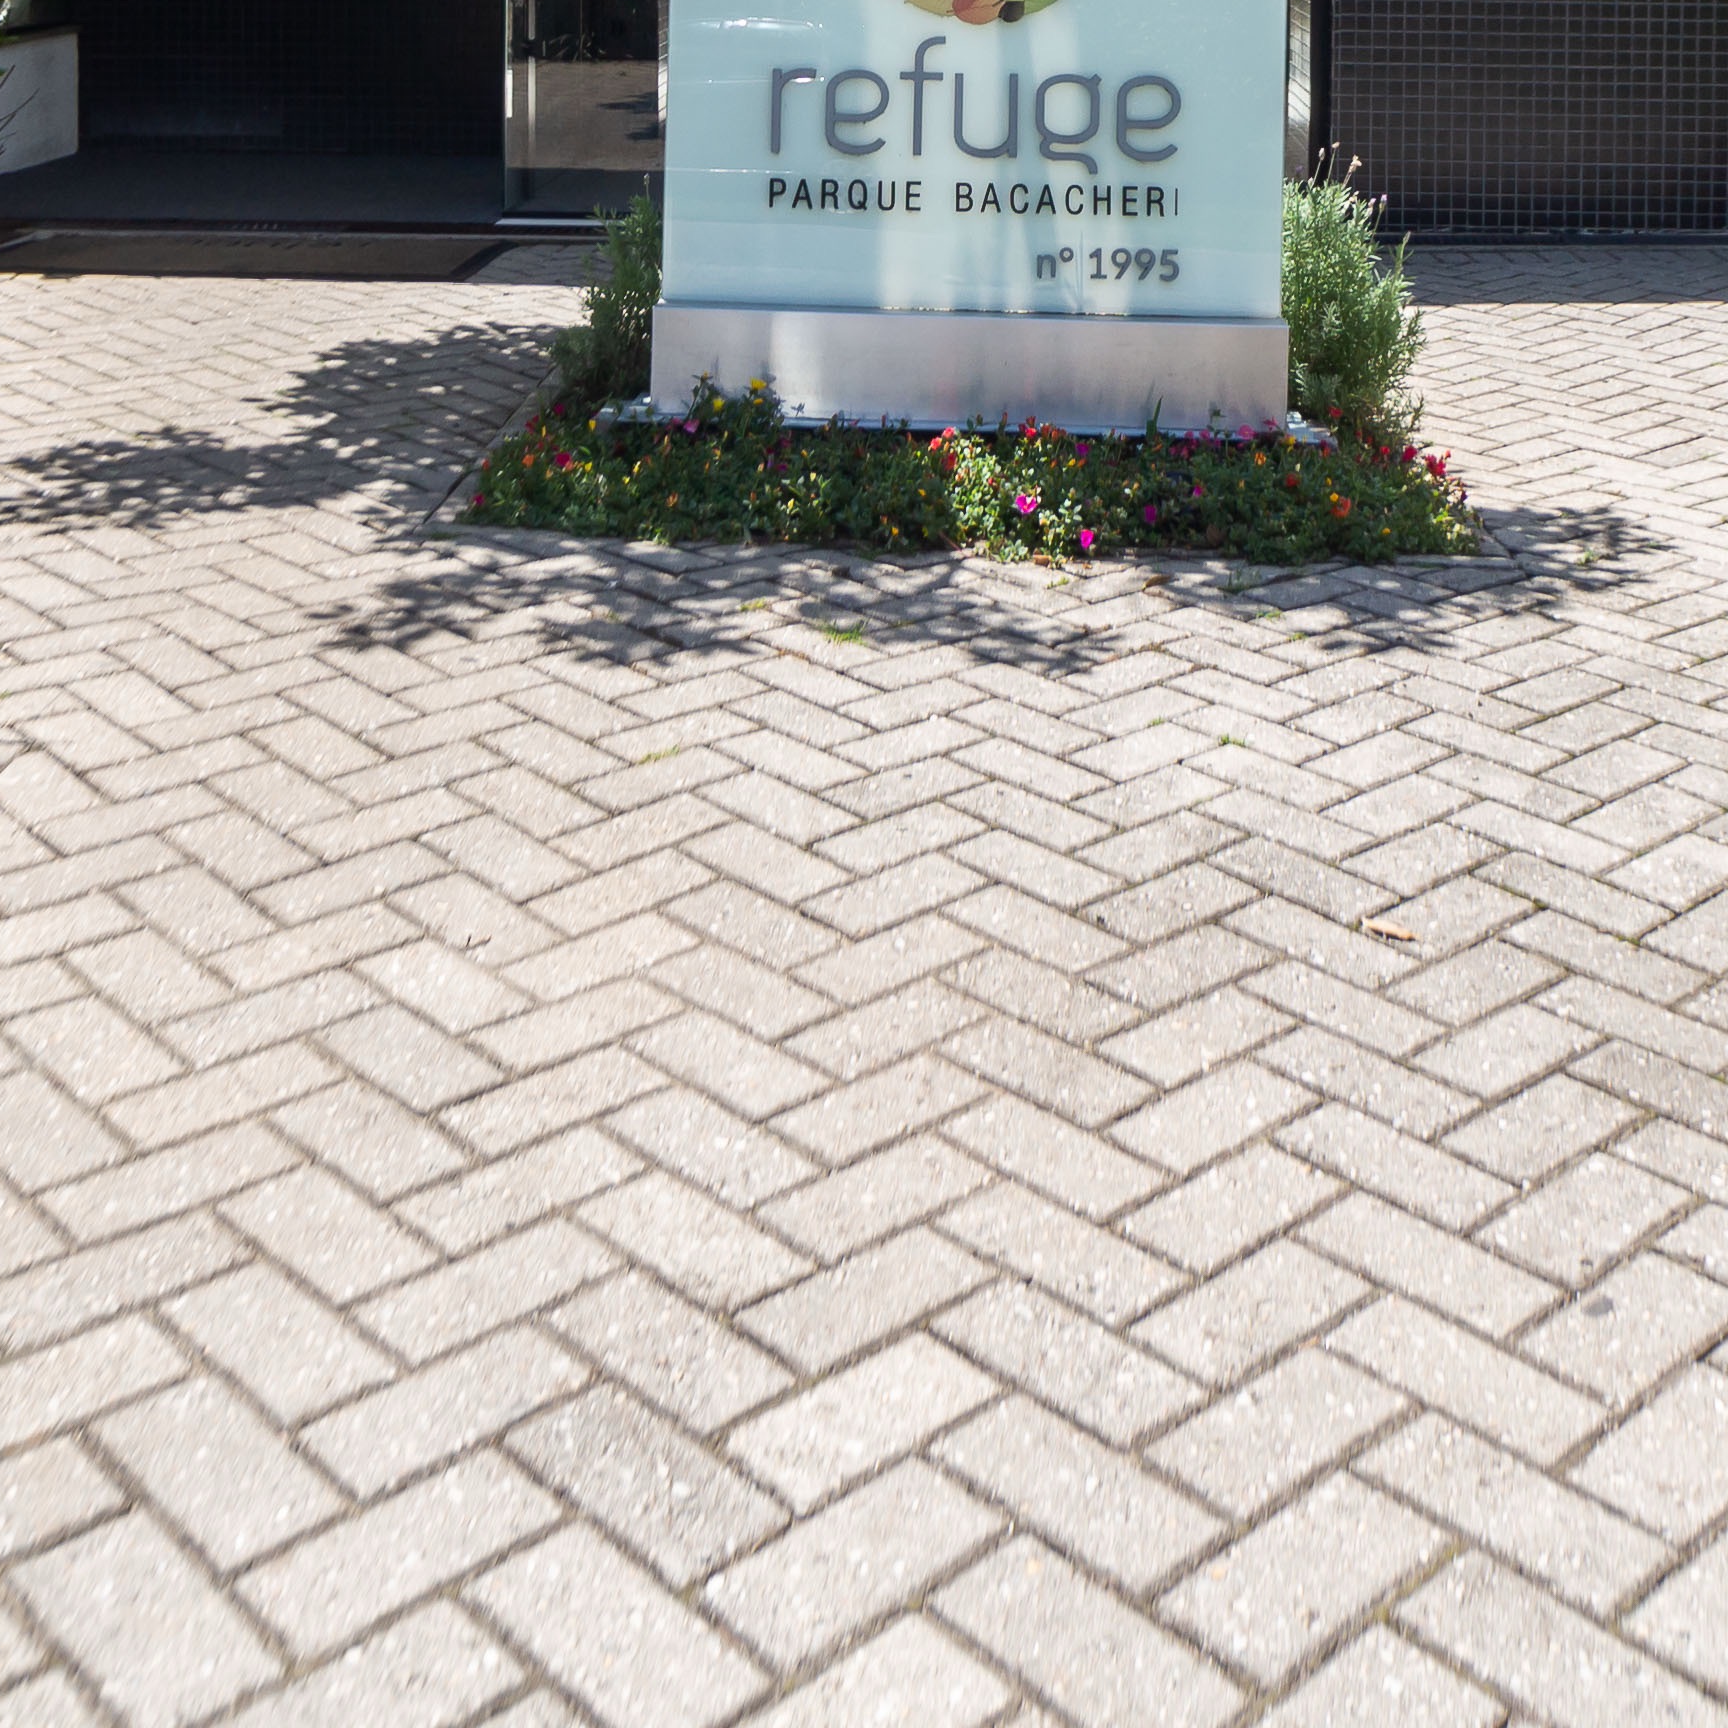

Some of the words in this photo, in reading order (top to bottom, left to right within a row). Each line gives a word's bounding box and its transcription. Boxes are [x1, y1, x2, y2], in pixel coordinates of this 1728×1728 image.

[769, 36, 1182, 175] refuge
[768, 178, 923, 212] PARQUE
[954, 181, 1180, 217] BACACHERI
[1088, 247, 1181, 282] 1995
